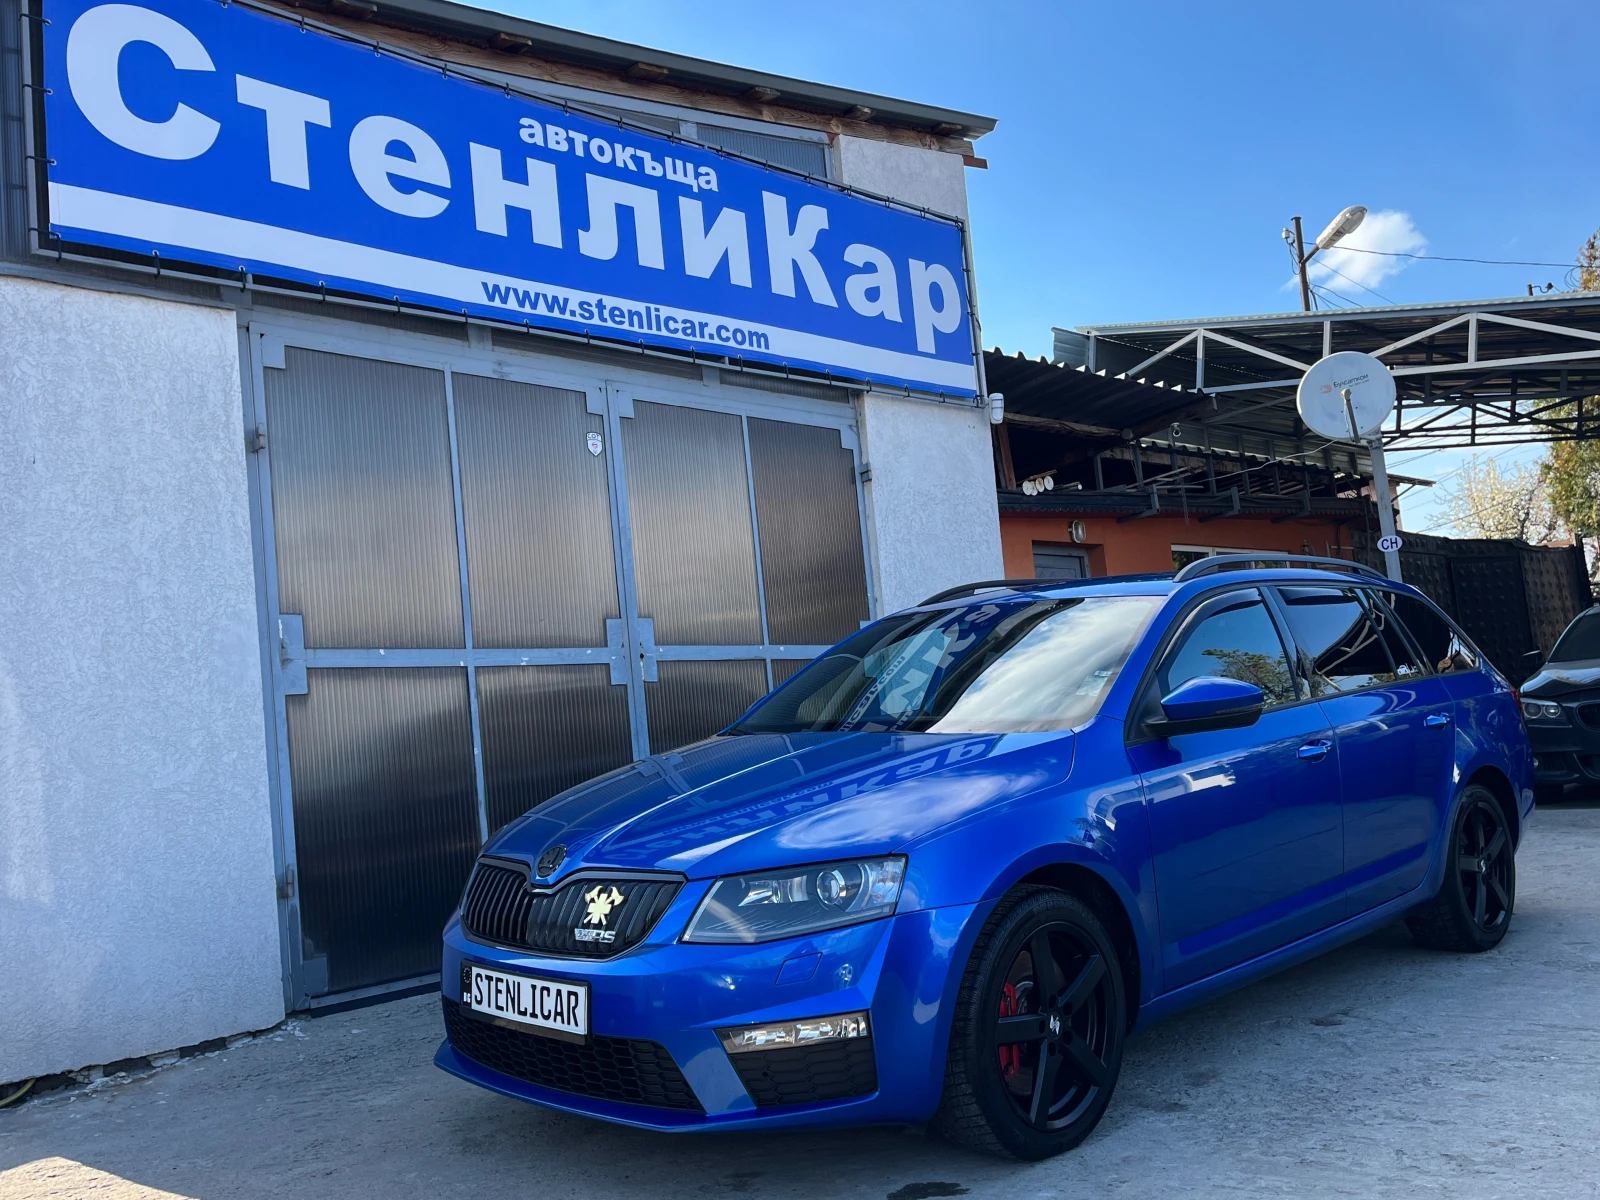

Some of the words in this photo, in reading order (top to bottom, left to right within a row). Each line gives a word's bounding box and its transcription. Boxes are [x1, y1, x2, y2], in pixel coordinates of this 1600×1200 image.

[67, 4, 962, 354] СтенлиКар
[519, 117, 719, 193] автокъща
[481, 281, 769, 350] www.stenlicar.com
[1381, 537, 1399, 550] CH
[474, 973, 579, 1027] STENLICAR
